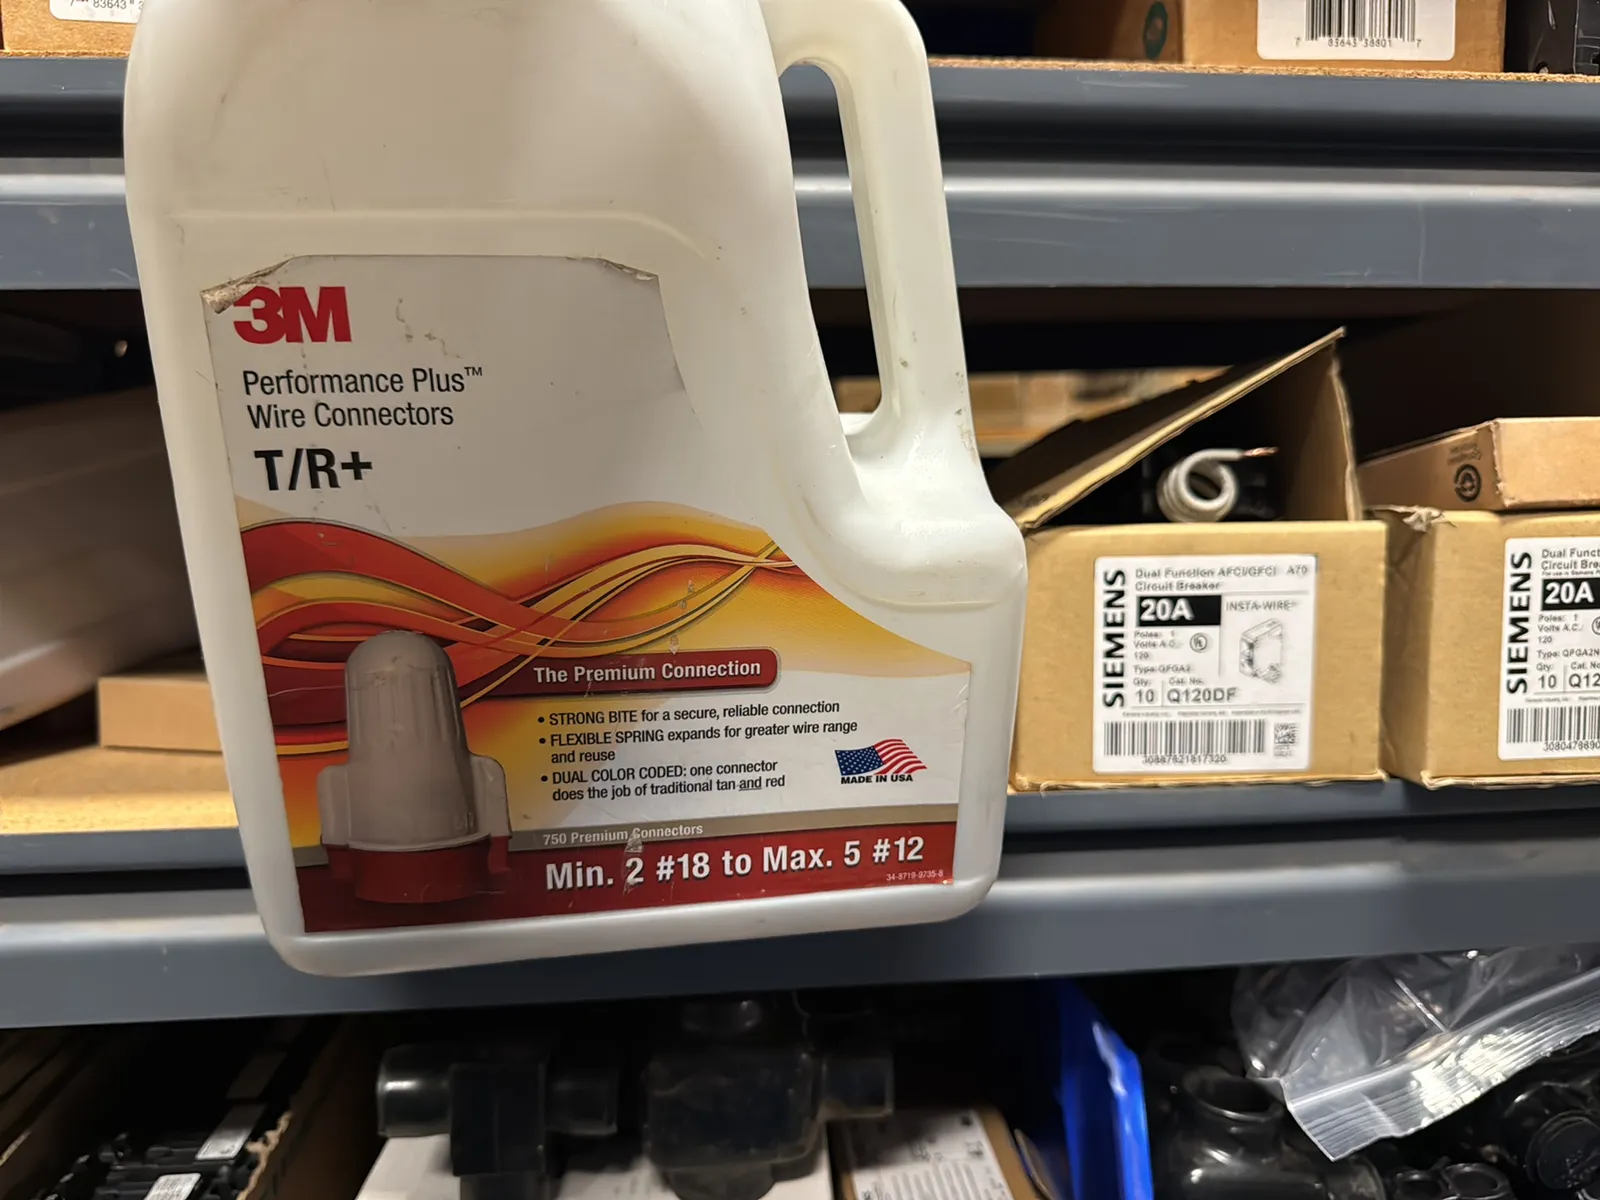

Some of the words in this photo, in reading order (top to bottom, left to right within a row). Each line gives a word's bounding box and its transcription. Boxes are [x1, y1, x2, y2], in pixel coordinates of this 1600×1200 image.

[233, 286, 352, 344] 3M
[243, 369, 404, 396] Performance
[247, 403, 306, 429] Wire
[314, 401, 454, 427] Connectors
[254, 447, 373, 491] T/R+
[1542, 548, 1566, 558] Dual
[1136, 568, 1161, 578] Dual
[1164, 566, 1215, 578] Function
[1541, 560, 1578, 570] Circuit
[1135, 581, 1173, 591] Circuit
[1176, 580, 1221, 590] Breaker
[1544, 581, 1595, 604] 20A
[1140, 597, 1195, 621] 20A
[1506, 552, 1532, 694] SIEMENS
[1538, 624, 1560, 632] Volts
[1102, 569, 1126, 708] SIEMENS
[1538, 636, 1552, 644] 120
[533, 667, 568, 683] The
[574, 664, 655, 682] Premium
[661, 660, 761, 680] Connection
[1538, 674, 1556, 688] 10
[1136, 688, 1154, 703] 10
[1167, 687, 1238, 704] Q120DF
[549, 711, 605, 726] STRONG
[609, 710, 638, 724] BITE
[641, 709, 659, 722] for
[662, 712, 671, 721] a
[674, 708, 719, 721] secure,
[723, 703, 769, 718] reliable
[772, 700, 840, 716] connection
[550, 732, 612, 747] FLEXIBLE
[615, 729, 664, 744] SPRING
[667, 727, 721, 743] expands
[724, 725, 741, 738] for
[745, 723, 789, 740] greater
[792, 721, 819, 735] wire
[823, 721, 858, 735] range
[551, 750, 575, 764] and
[579, 751, 615, 763] reuse
[552, 771, 588, 784] DUAL
[591, 767, 635, 782] COLOR
[639, 765, 687, 780] CODED:
[690, 766, 713, 777] one
[716, 760, 778, 775] connector
[840, 776, 872, 784] MADE
[890, 774, 913, 782] USA
[552, 787, 584, 801] does
[587, 785, 608, 799] the
[611, 784, 631, 800] job
[635, 783, 647, 796] of
[650, 779, 713, 796] traditional
[716, 779, 736, 791] tan
[739, 776, 762, 790] and
[765, 775, 785, 788] red
[543, 834, 567, 846] 750
[571, 829, 628, 843] Premium
[632, 824, 703, 840] Connectors
[546, 860, 614, 890] Min.
[625, 857, 645, 884] 2
[656, 852, 710, 881] #18
[721, 850, 752, 876] to
[763, 845, 832, 873] Max.
[844, 840, 861, 866] 5
[872, 836, 924, 863] #12
